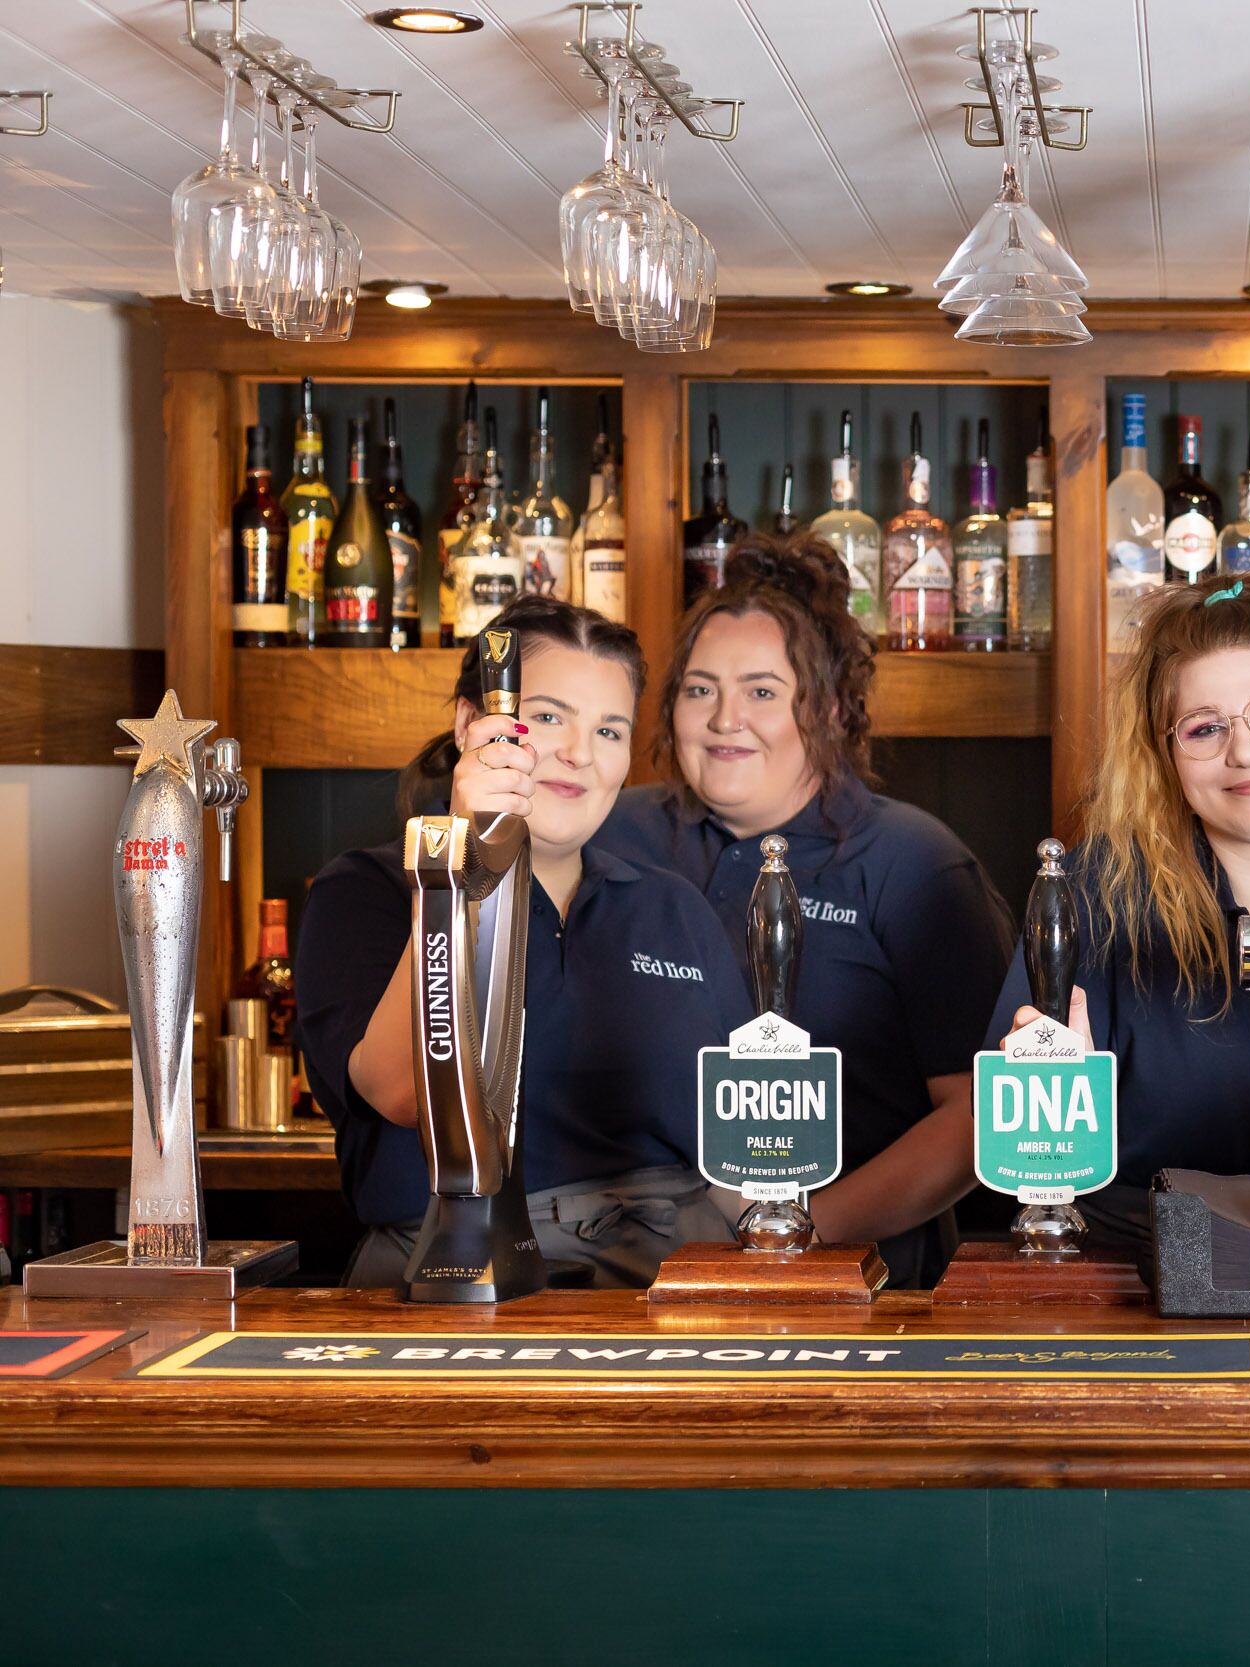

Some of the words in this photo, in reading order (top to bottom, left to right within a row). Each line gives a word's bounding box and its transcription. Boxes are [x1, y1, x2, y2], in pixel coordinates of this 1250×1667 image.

[117, 836, 187, 857] strela
[123, 855, 169, 872] Damm
[800, 901, 820, 919] ed
[819, 901, 857, 924] lion
[634, 952, 652, 962] the
[630, 959, 664, 977] red
[663, 961, 704, 982] lion
[426, 932, 453, 1061] GUINNESS
[737, 1043, 772, 1054] Charlie
[773, 1043, 802, 1054] Wells
[1012, 1047, 1048, 1059] Charlie
[1049, 1047, 1078, 1058] Wells
[715, 1079, 826, 1121] ORIGIN
[992, 1075, 1099, 1133] DNA
[747, 1136, 772, 1149] PALE
[774, 1136, 794, 1149] ALE
[1016, 1141, 1051, 1153] AMBER
[1055, 1141, 1074, 1153] ALE
[721, 1162, 741, 1174] BORN
[742, 1167, 747, 1175] &
[749, 1167, 776, 1176] BREWED
[788, 1162, 819, 1175] BEDFORD
[997, 1166, 1017, 1177] BORN
[1018, 1171, 1023, 1179] &
[1024, 1172, 1052, 1180] BREWED
[1054, 1172, 1062, 1180] IN
[1063, 1166, 1094, 1180] BEDFORD
[135, 1198, 190, 1217] 1876
[391, 1347, 902, 1361] BREWPOINT
[1060, 1349, 1176, 1361] Beyond
